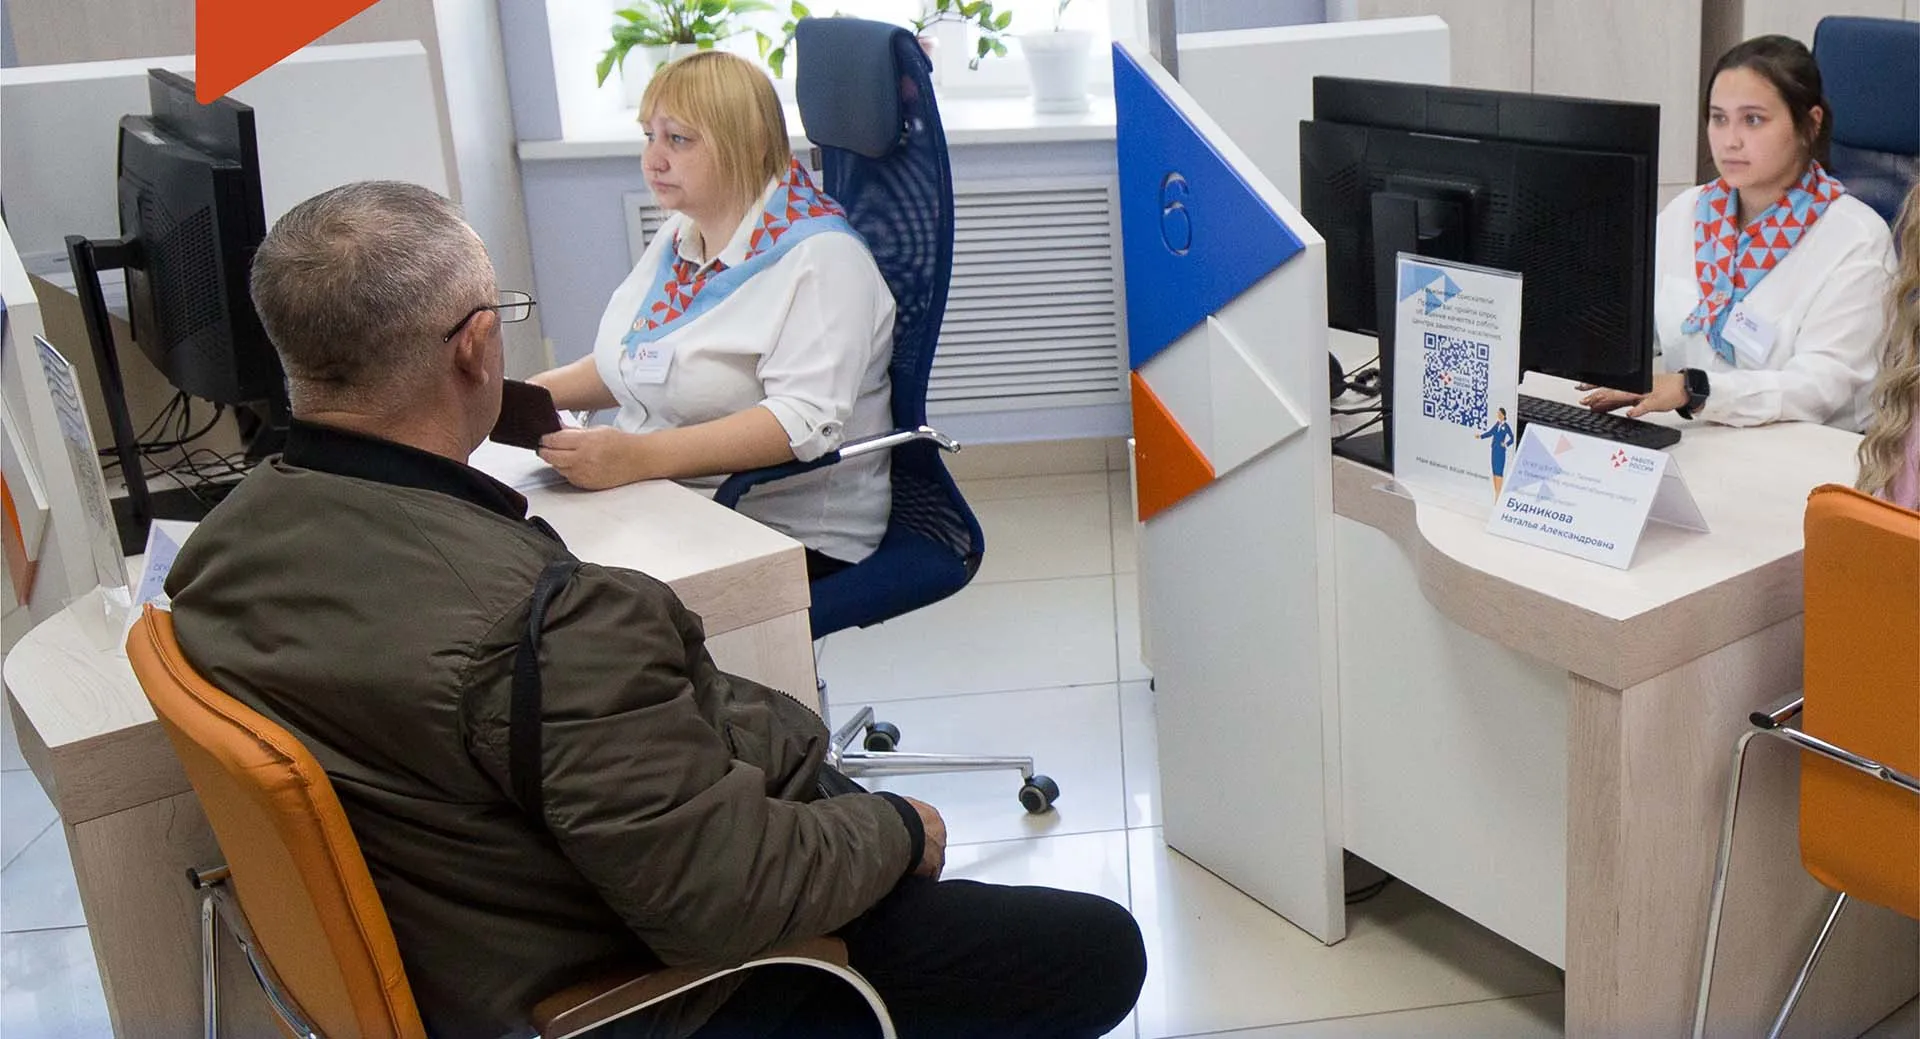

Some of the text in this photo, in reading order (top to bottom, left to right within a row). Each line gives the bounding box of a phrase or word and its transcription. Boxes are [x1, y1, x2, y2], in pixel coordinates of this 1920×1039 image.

[1160, 171, 1193, 256] 6
[1629, 462, 1654, 472] РОССИИ
[1630, 455, 1655, 466] РАБОТА
[1506, 497, 1574, 524] Будникова
[1500, 513, 1615, 550] Наталья Александровна
